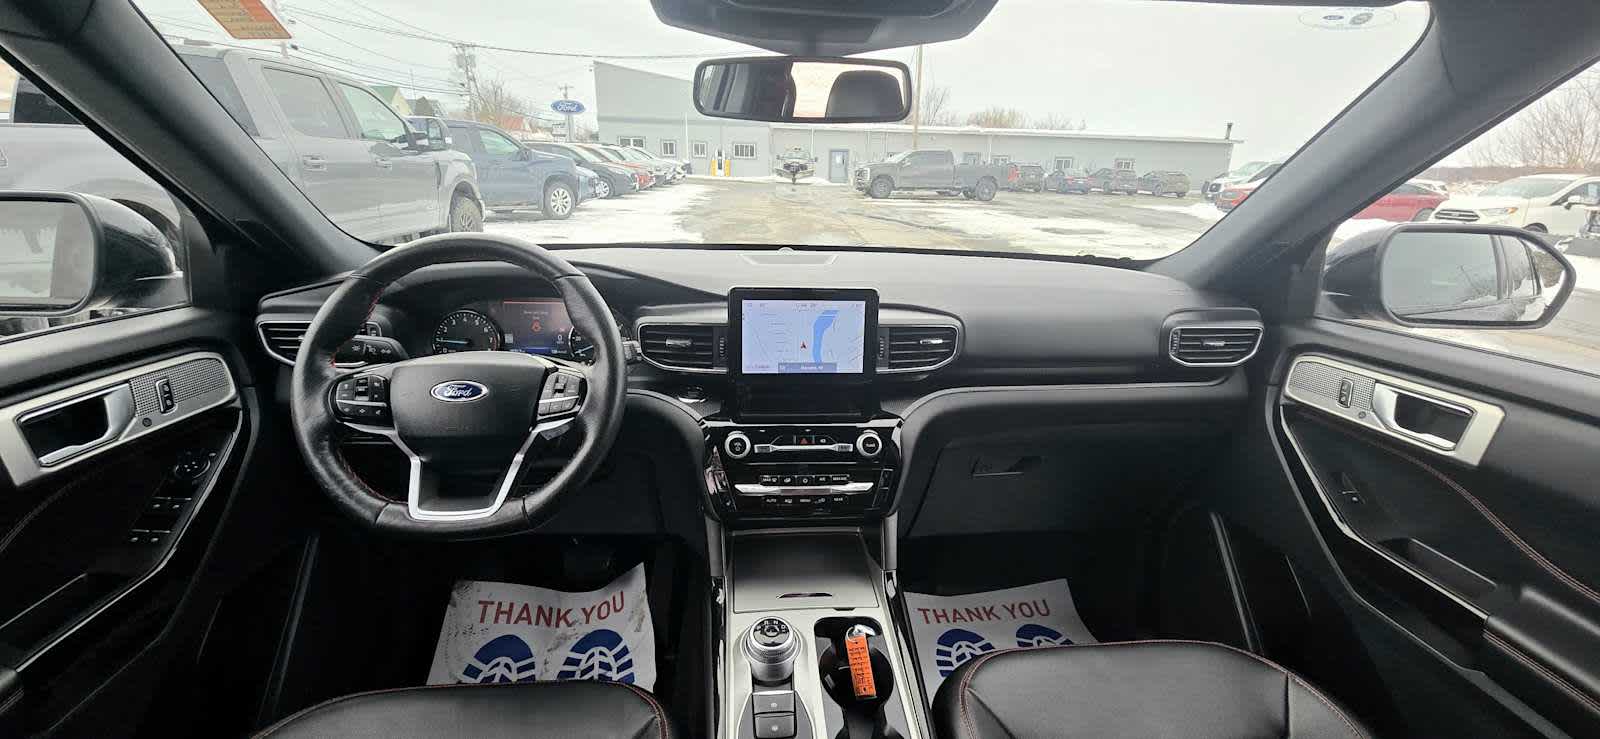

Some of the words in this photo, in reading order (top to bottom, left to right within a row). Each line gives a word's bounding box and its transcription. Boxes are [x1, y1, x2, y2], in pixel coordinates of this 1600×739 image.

[478, 600, 573, 629] THANK
[581, 590, 625, 625] YOU
[917, 605, 1001, 625] THANK
[1002, 599, 1051, 620] YOU
